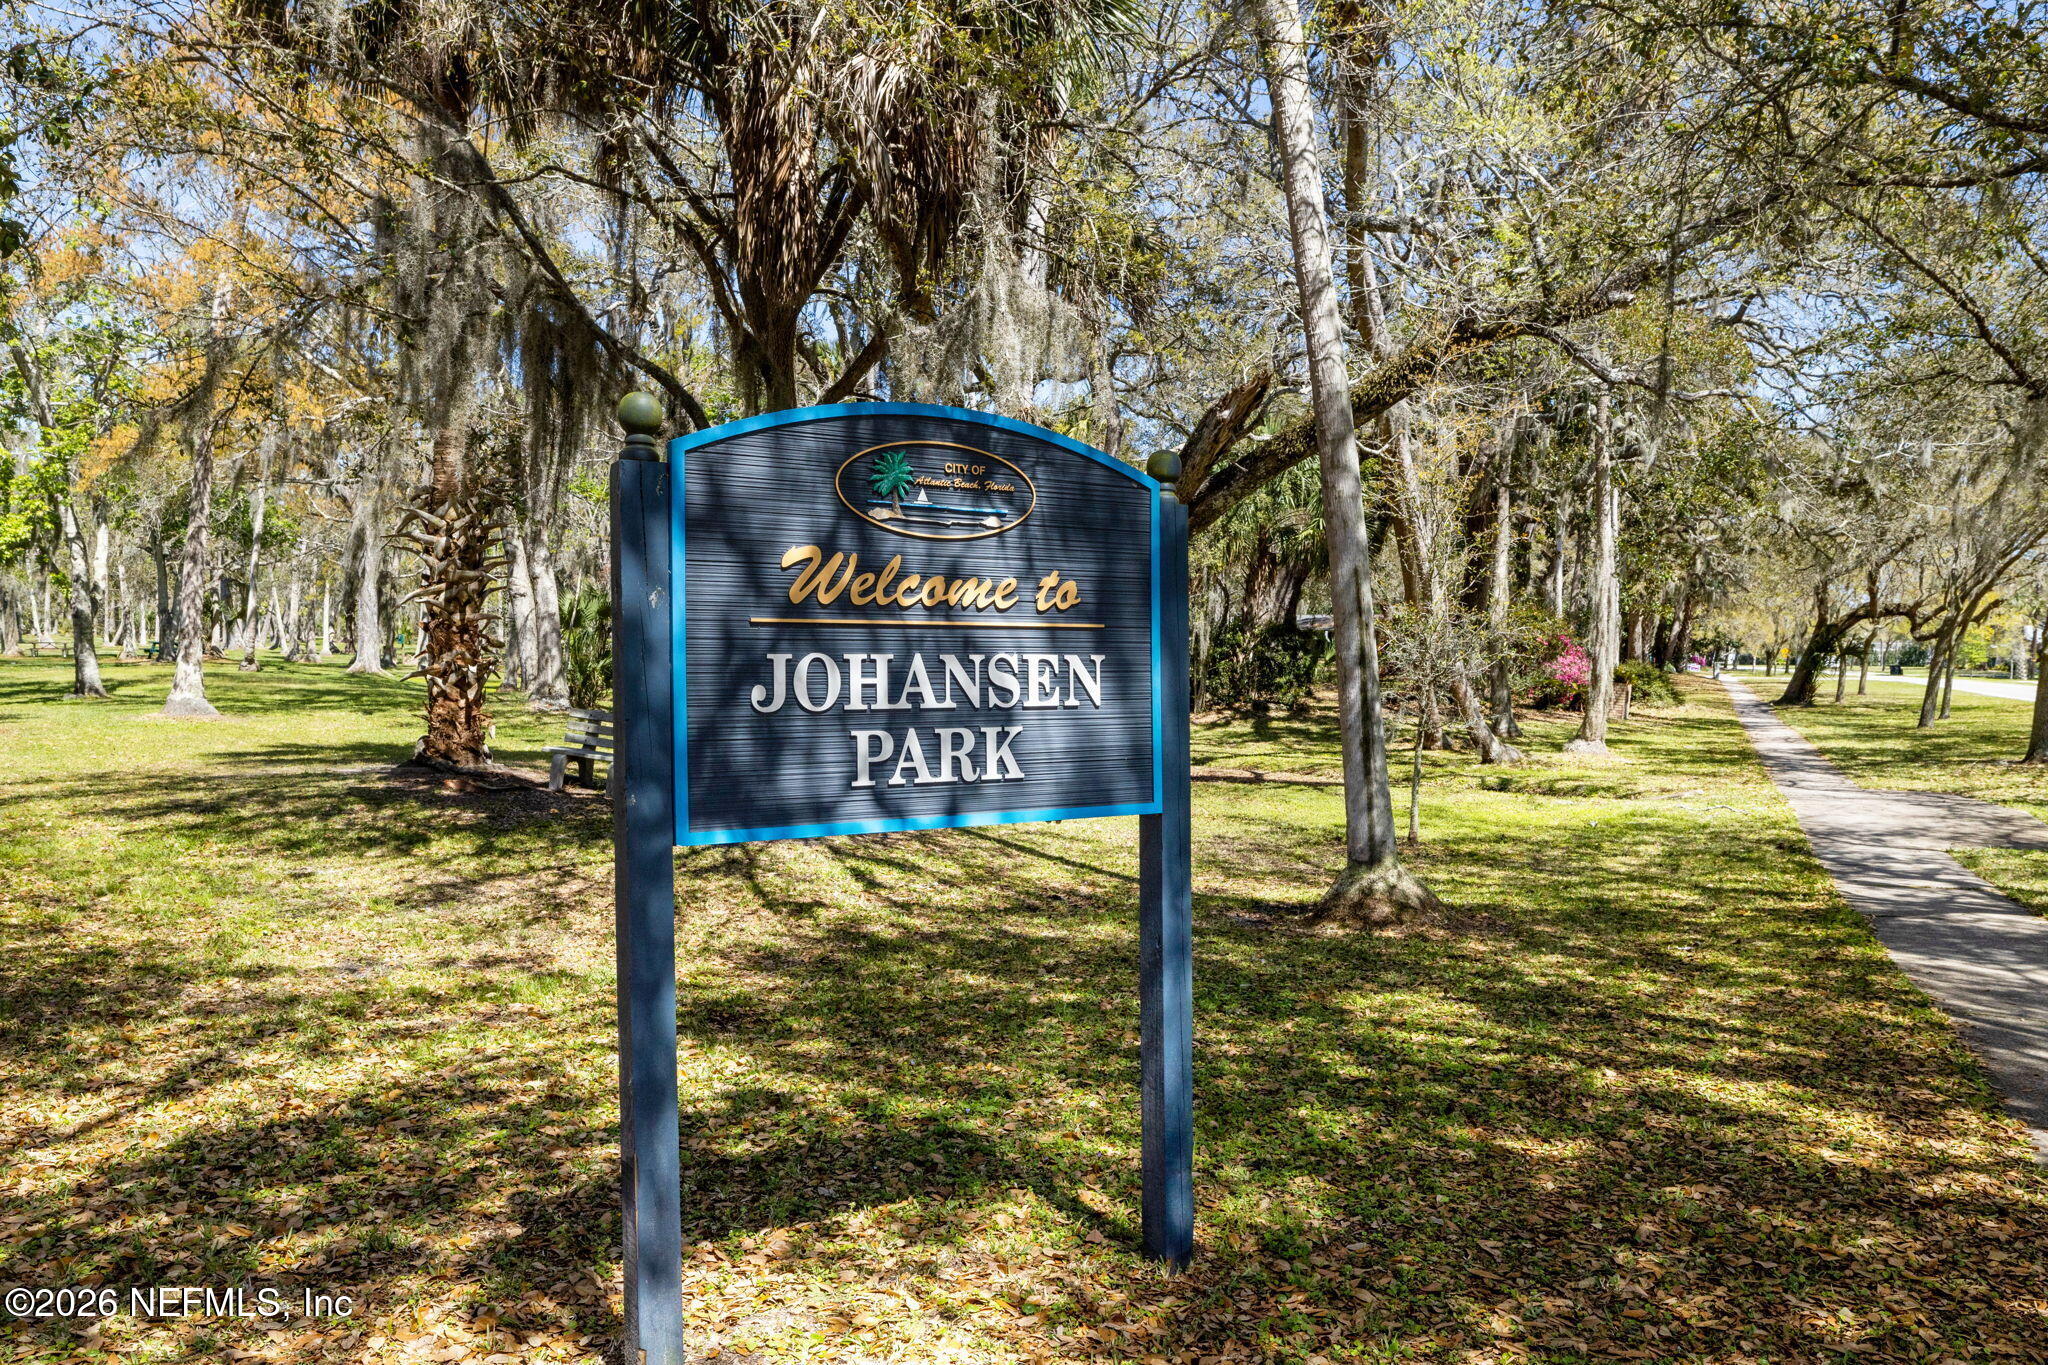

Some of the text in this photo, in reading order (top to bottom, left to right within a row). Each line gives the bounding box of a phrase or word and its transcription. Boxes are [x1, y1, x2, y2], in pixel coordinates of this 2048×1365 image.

[914, 475, 951, 488] Atlantic
[984, 480, 1016, 492] Florida
[944, 462, 986, 475] CITY OF
[780, 545, 1082, 612] Welcome to
[750, 652, 1105, 713] JOHANSEN
[850, 725, 1025, 787] PARK
